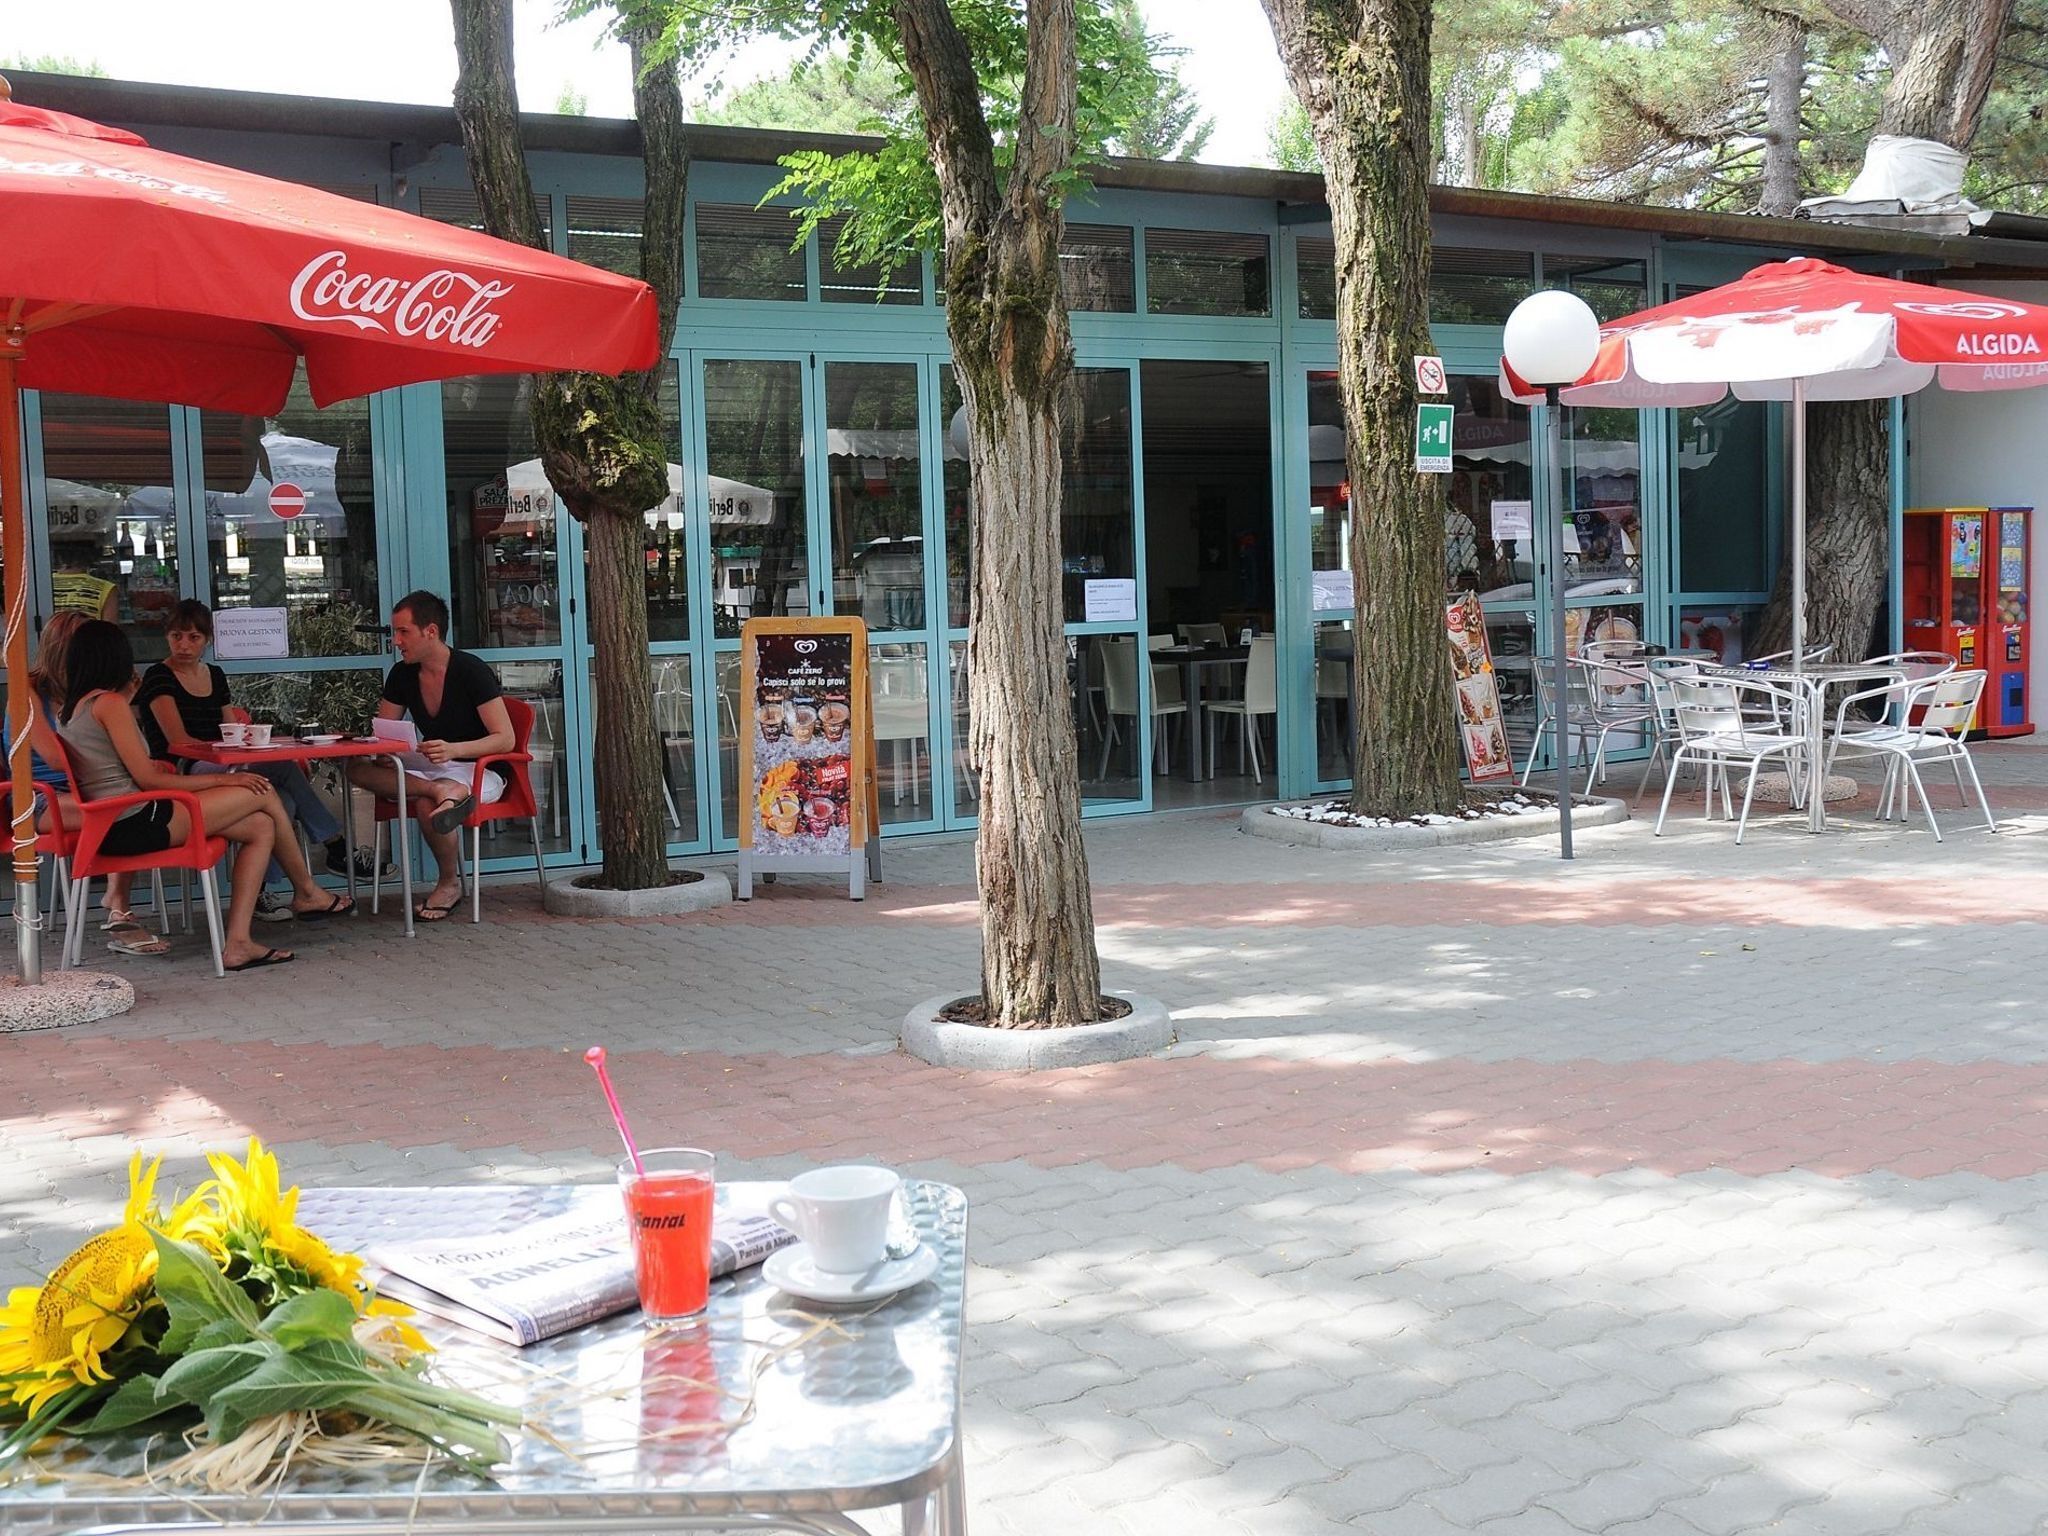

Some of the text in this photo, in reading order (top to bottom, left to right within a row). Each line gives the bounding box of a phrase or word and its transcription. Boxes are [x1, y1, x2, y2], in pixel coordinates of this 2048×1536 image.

[290, 250, 515, 348] Coca-Cola
[1956, 333, 2041, 355] ALGIDA
[220, 628, 282, 637] NUOVA GESTIONE
[763, 677, 788, 688] Capisci
[790, 677, 806, 686] solo
[817, 677, 825, 686] lo
[826, 677, 846, 687] provi
[821, 764, 846, 778] Novità
[739, 1245, 764, 1259] Parola
[468, 1247, 620, 1289] AGNELLI
